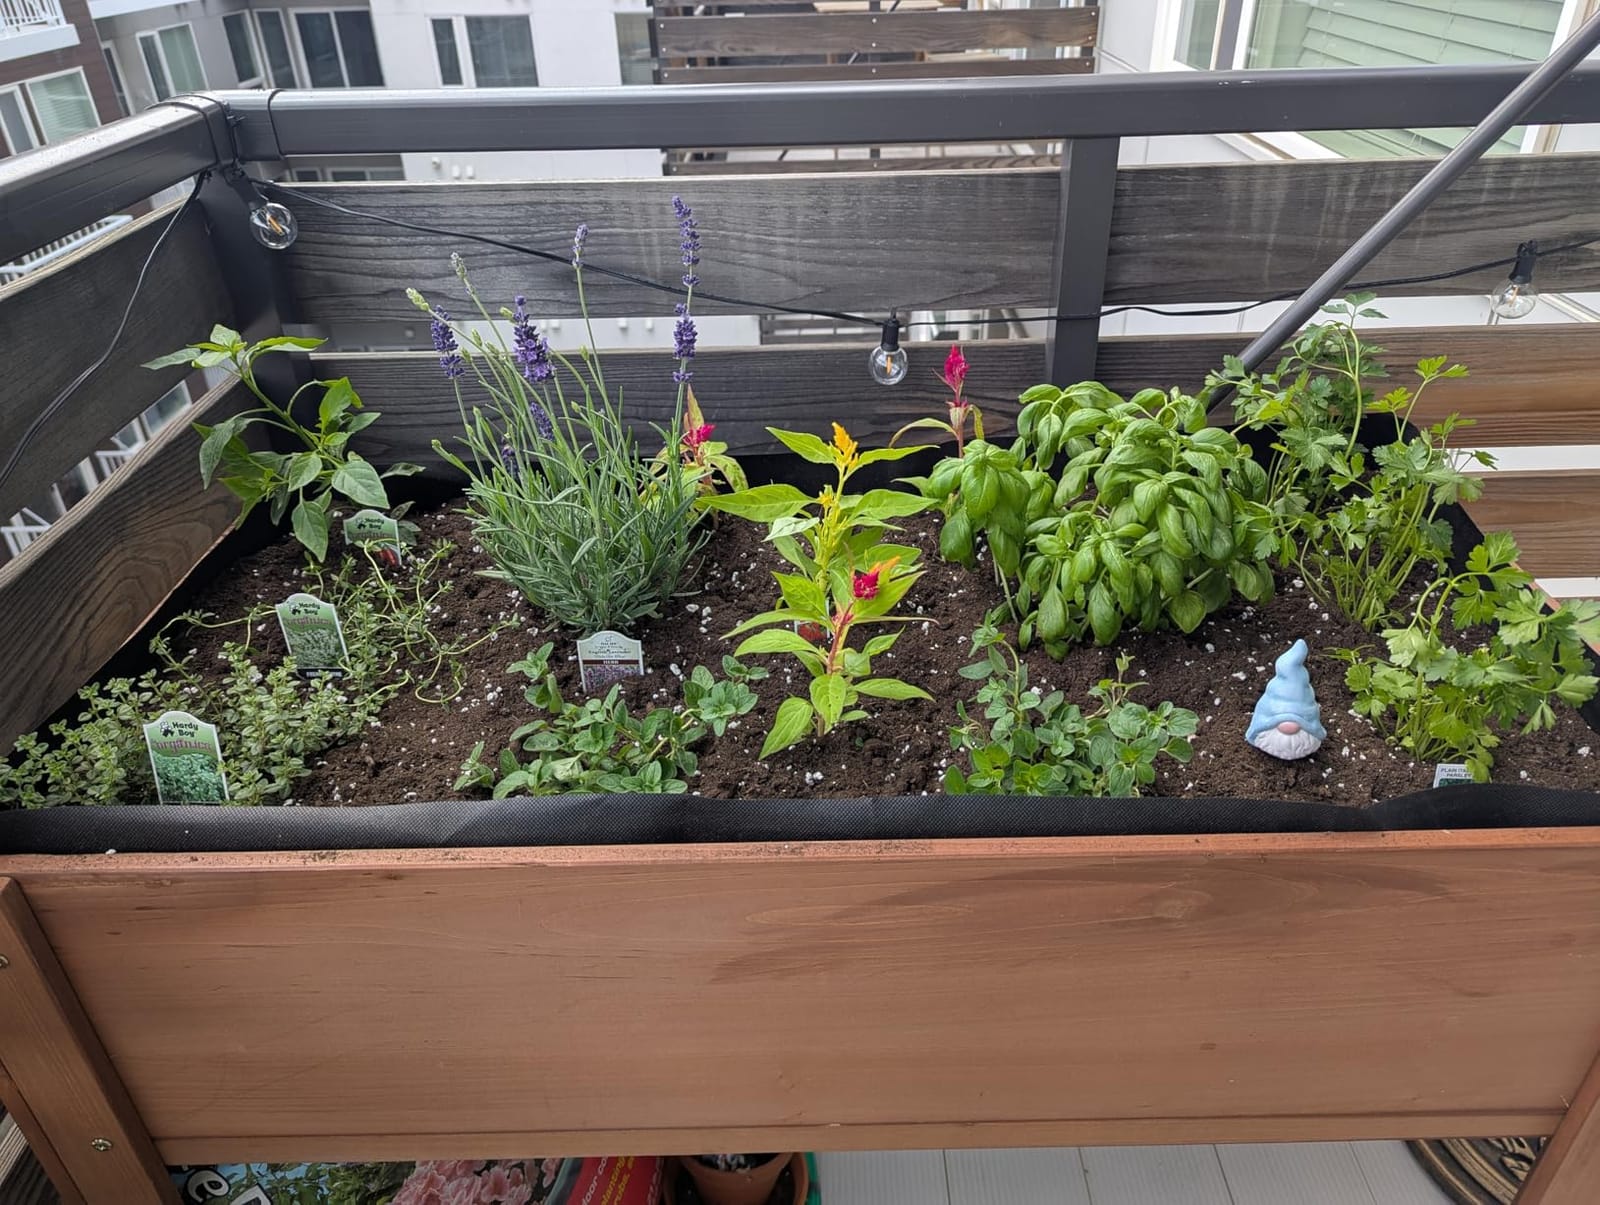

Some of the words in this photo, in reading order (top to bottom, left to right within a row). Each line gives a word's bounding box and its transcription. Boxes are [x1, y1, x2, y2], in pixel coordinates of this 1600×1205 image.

[298, 602, 321, 610] Hardy
[304, 608, 318, 616] Boy
[171, 721, 199, 731] Hardy
[178, 729, 195, 738] Boy
